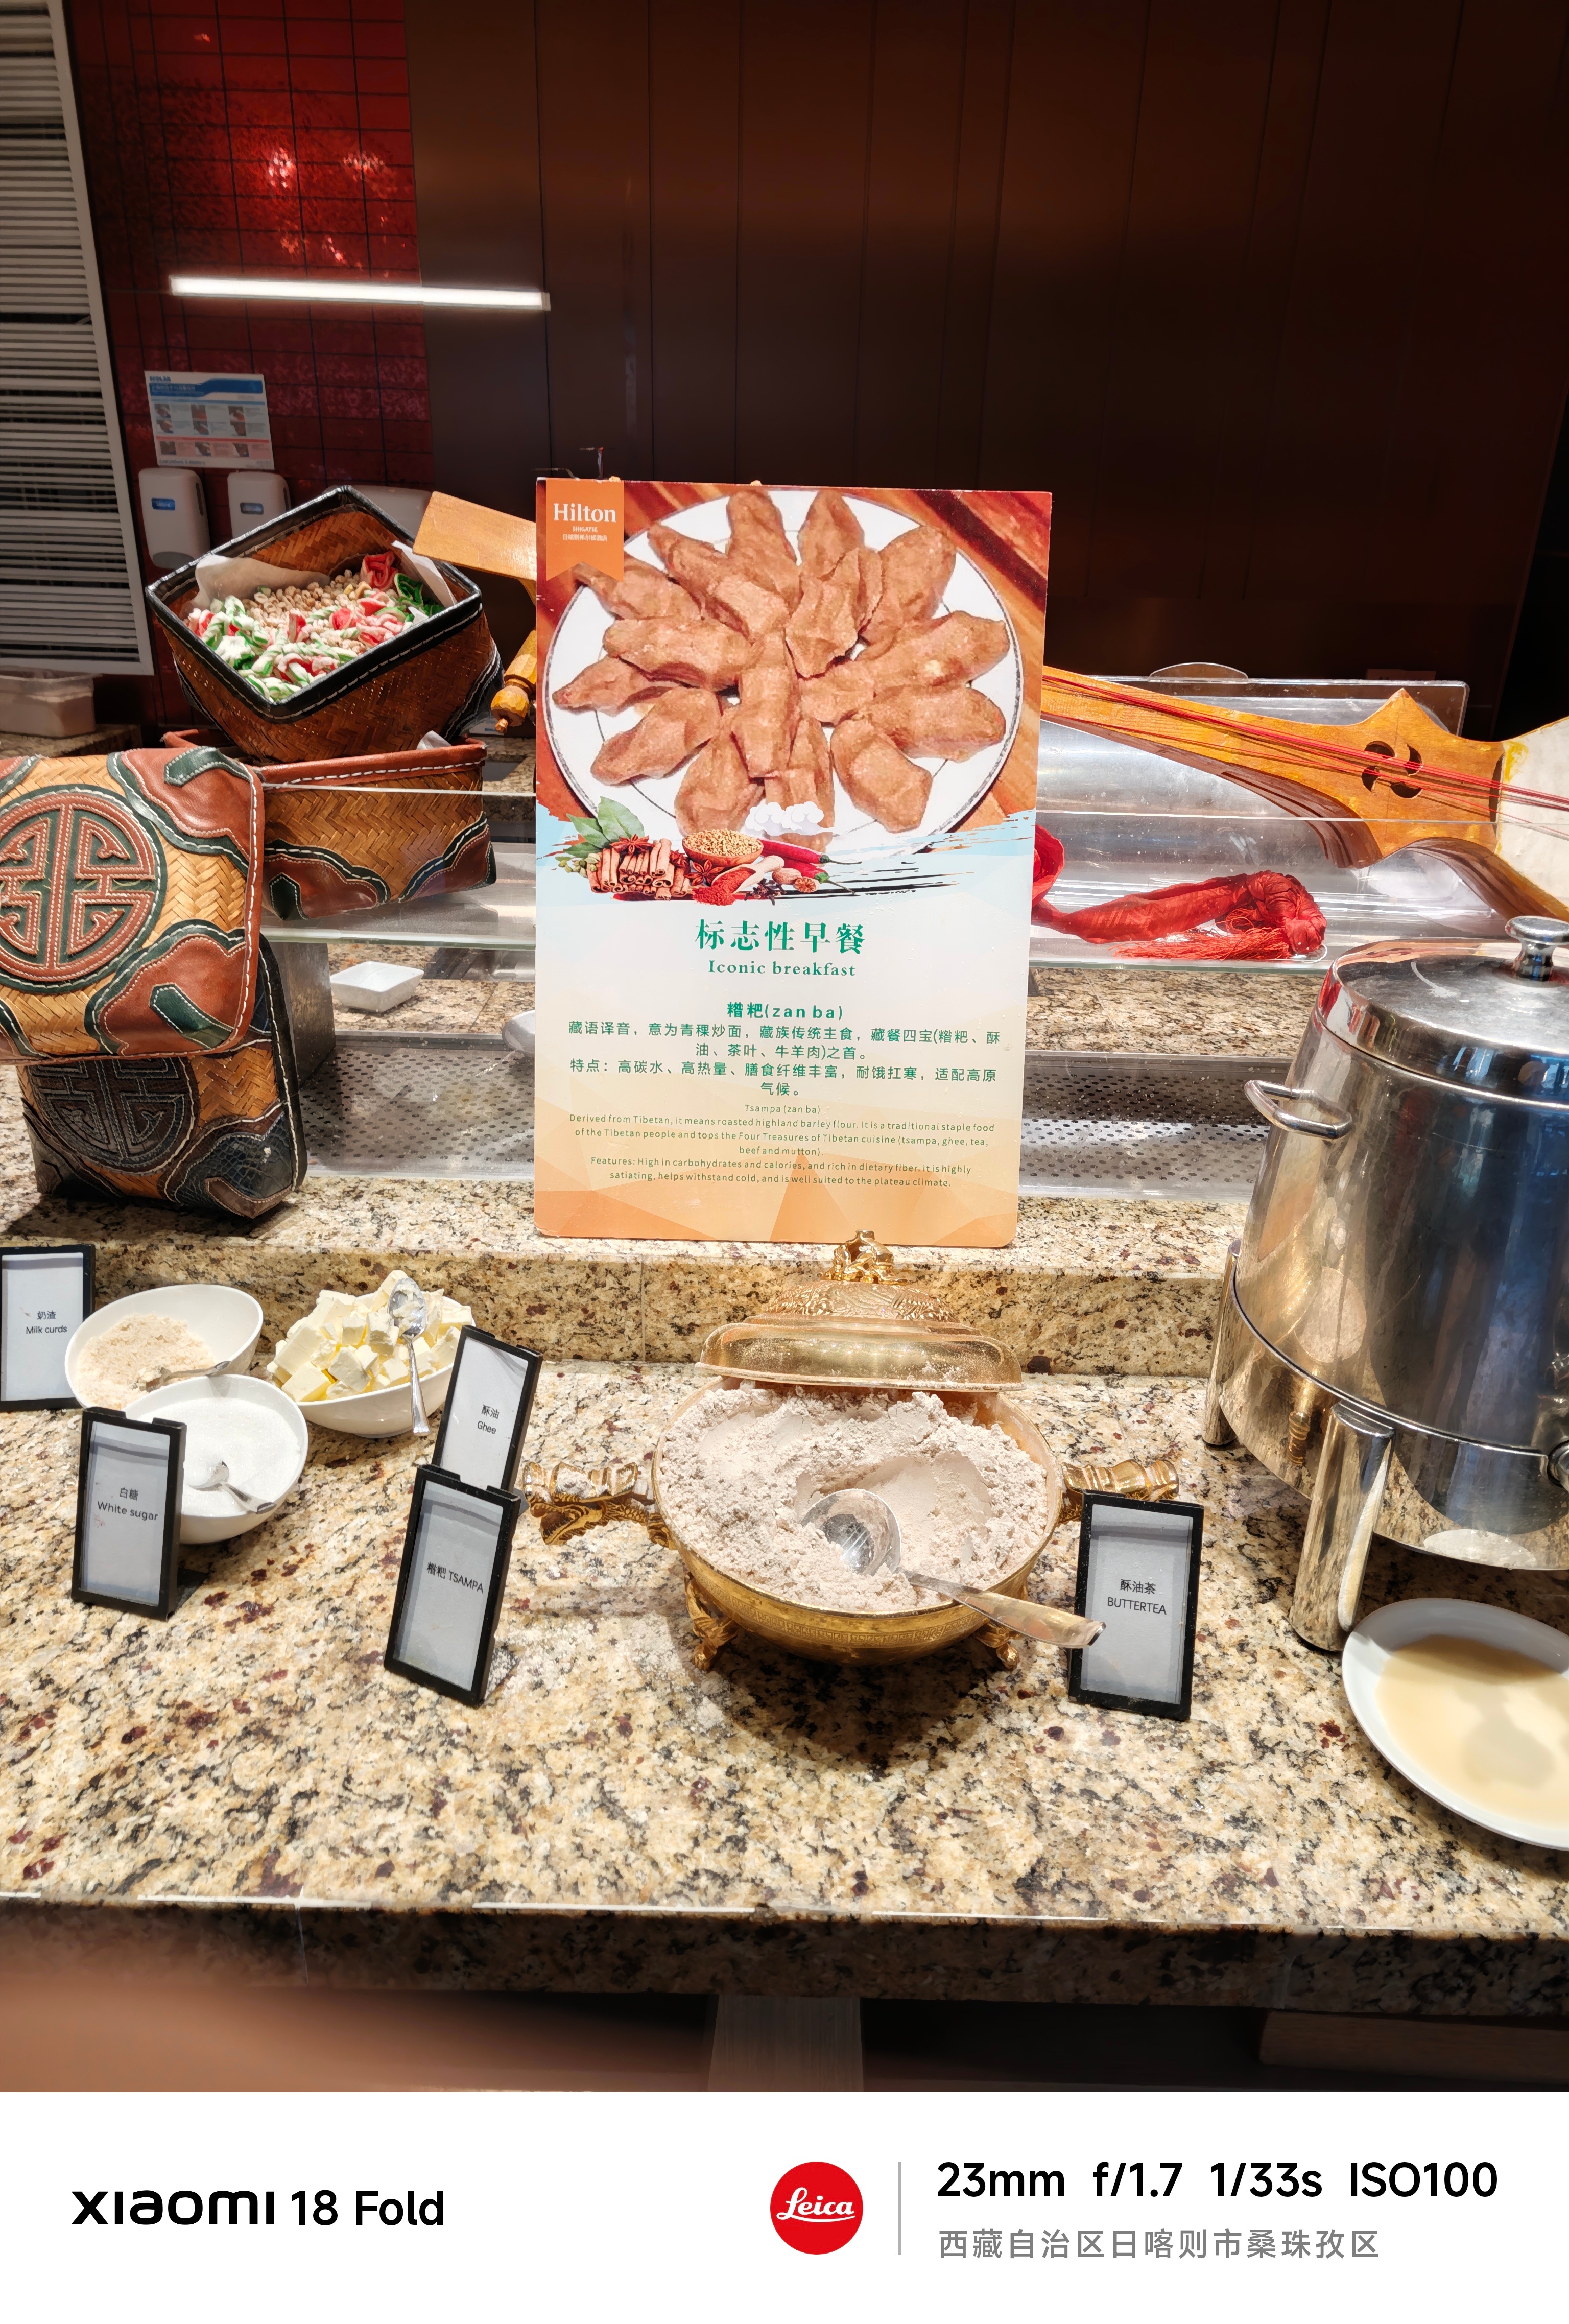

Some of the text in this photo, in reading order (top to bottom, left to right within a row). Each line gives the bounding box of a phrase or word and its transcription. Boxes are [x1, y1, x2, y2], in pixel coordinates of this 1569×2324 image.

[553, 503, 616, 523] Hilton
[696, 919, 865, 955] 标志性早餐
[708, 960, 855, 976] Iconic breakfast
[813, 1005, 843, 1021] ba)
[760, 1081, 799, 1096] 气候。
[744, 1104, 820, 1116] Tsampa (zan ba)
[569, 1113, 606, 1123] Derived
[608, 1114, 631, 1124] from
[633, 1115, 673, 1126] Tibetan,
[675, 1116, 682, 1125] it
[718, 1118, 753, 1126] roasted
[756, 1118, 798, 1129] highland
[801, 1118, 831, 1130] barley
[833, 1120, 859, 1129] flour.
[861, 1121, 868, 1129] It
[870, 1121, 878, 1129] is
[887, 1121, 939, 1131] traditional
[941, 1123, 971, 1133] staple
[973, 1123, 994, 1132] food
[575, 1127, 988, 1147] of the Tibetan people and tops the Four Treasures of Tibetan cuisine (tsampa, ghee, tea,
[739, 1145, 823, 1157] beef and mutton).
[590, 1156, 971, 1176] Features: High in carbohydrates and calories, and rich in dietary fiber. It is highly
[609, 1171, 656, 1182] satiating,
[658, 1171, 684, 1182] helps
[685, 1172, 733, 1182] withstand
[735, 1173, 760, 1184] cold,
[762, 1174, 779, 1183] and
[781, 1175, 789, 1183] is
[790, 1175, 811, 1184] well
[813, 1176, 843, 1185] suited
[855, 1176, 872, 1185] the
[874, 1177, 911, 1187] plateau
[912, 1178, 951, 1187] climate.
[37, 1310, 56, 1320] 奶渣
[26, 1325, 67, 1335] Milk curds
[481, 1404, 499, 1419] 酥油
[478, 1420, 496, 1434] Ghee
[120, 1487, 138, 1501] 白糖
[98, 1501, 158, 1521] White sugar
[449, 1570, 483, 1594] TSAMPA
[1120, 1579, 1156, 1594] 酥油茶
[1108, 1597, 1167, 1615] BUTTERTEA
